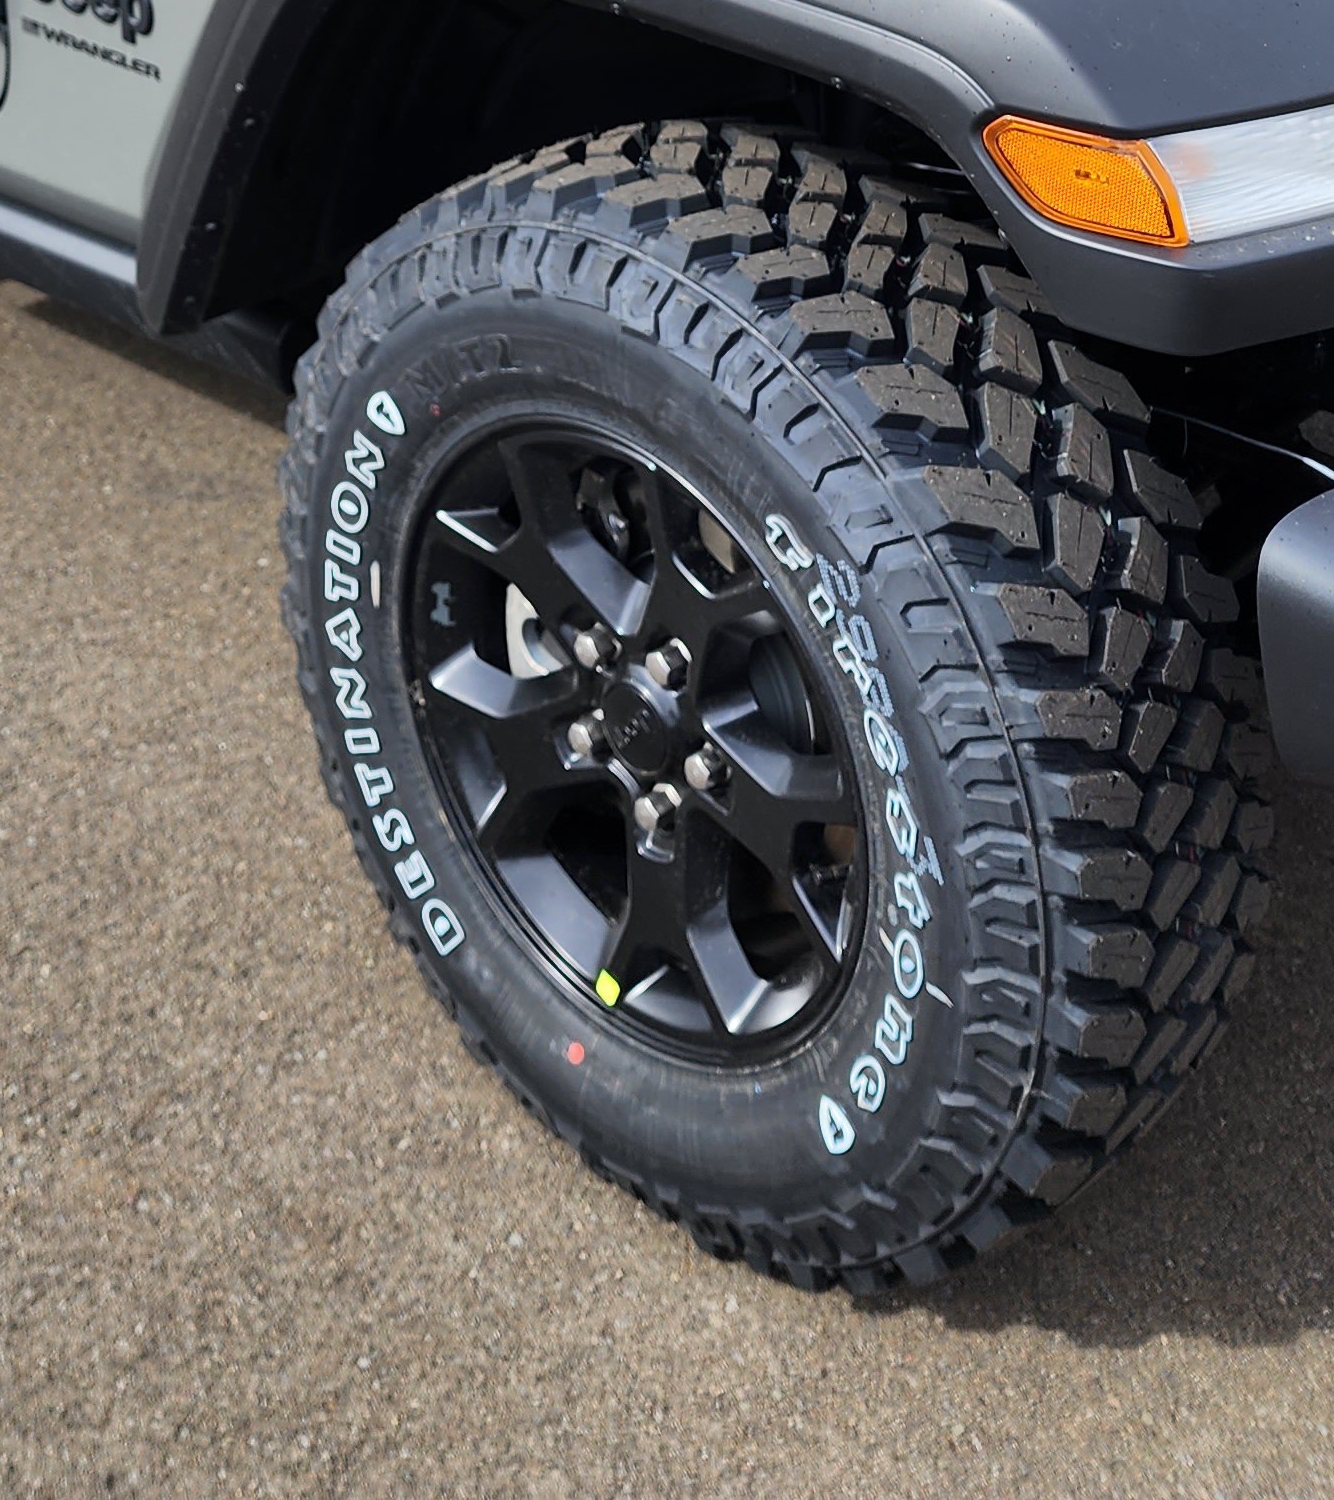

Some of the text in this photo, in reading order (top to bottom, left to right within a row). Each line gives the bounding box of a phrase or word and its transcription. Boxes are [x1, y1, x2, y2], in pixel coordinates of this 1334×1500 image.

[35, 22, 163, 82] WRANGLER
[324, 429, 466, 956] DESTINATION
[765, 513, 931, 1113] Firestone
